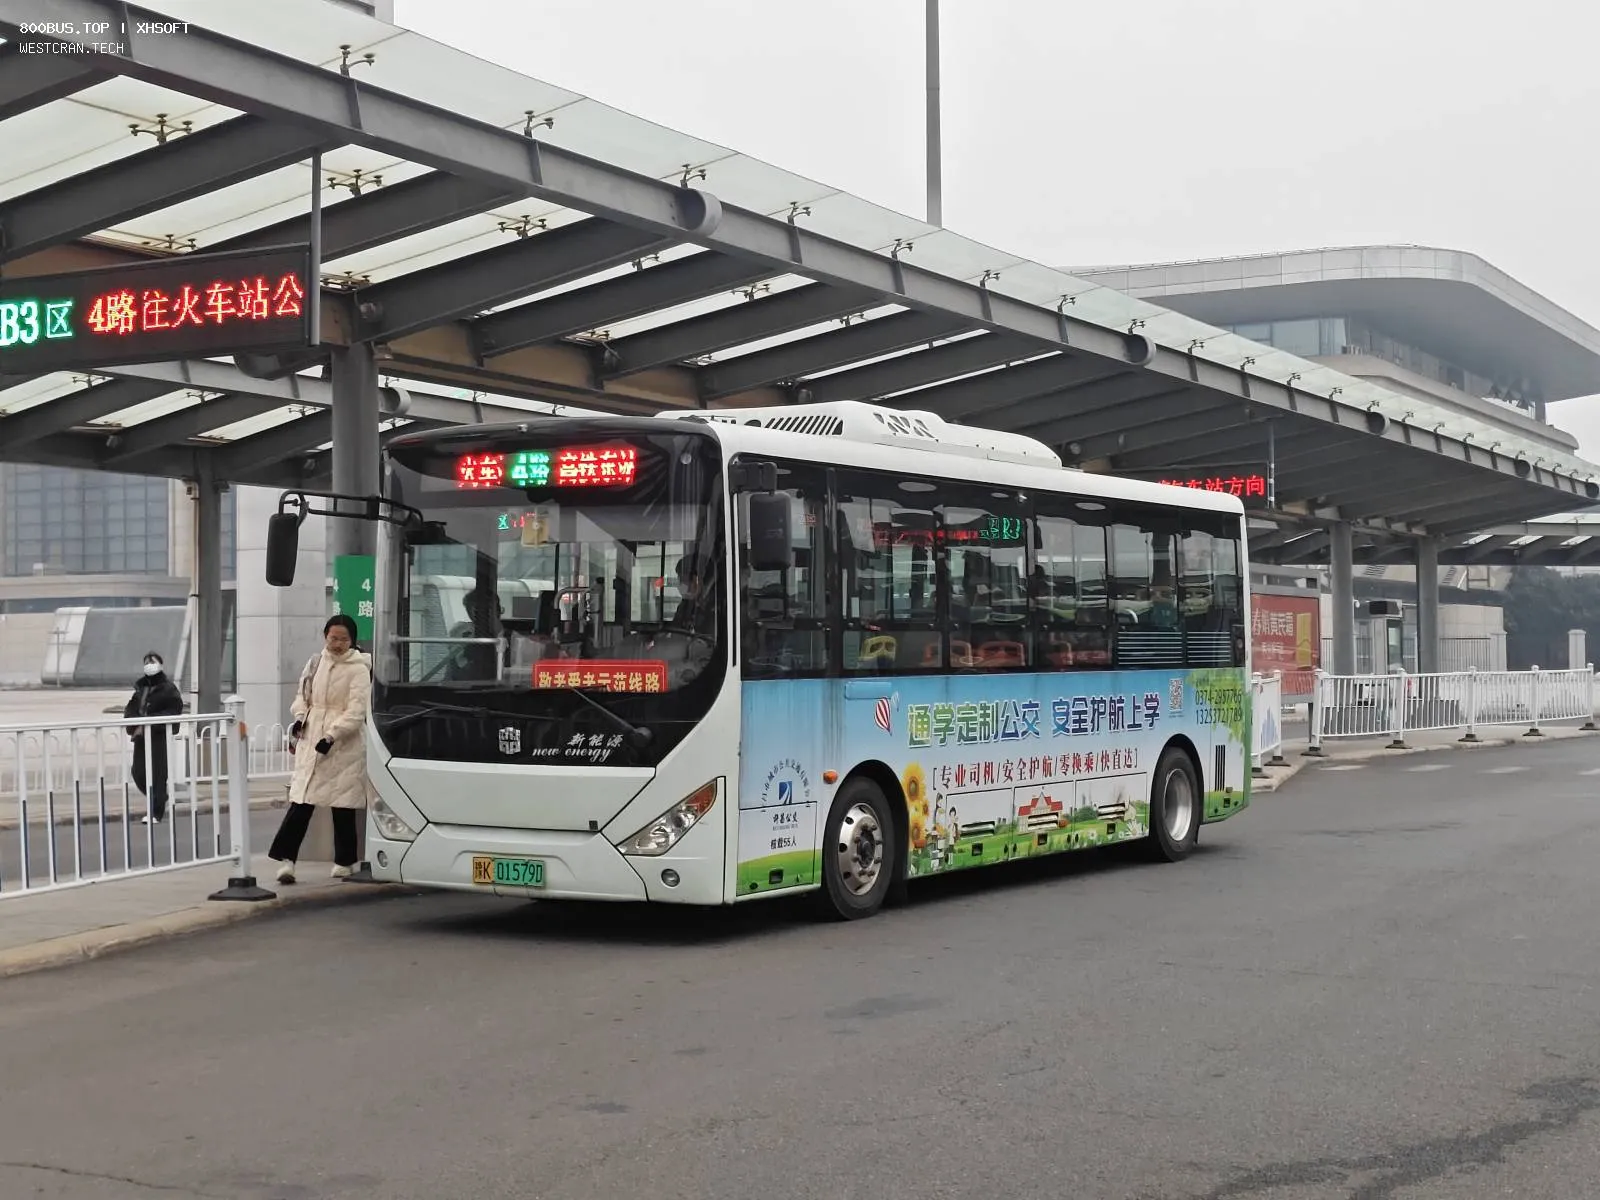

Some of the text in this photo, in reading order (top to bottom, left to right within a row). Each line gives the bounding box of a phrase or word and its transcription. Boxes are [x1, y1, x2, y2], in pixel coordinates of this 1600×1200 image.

[907, 693, 1161, 748] 通学定制公交 安全护航上学
[567, 733, 625, 748] 新能源
[532, 746, 612, 762] new energy
